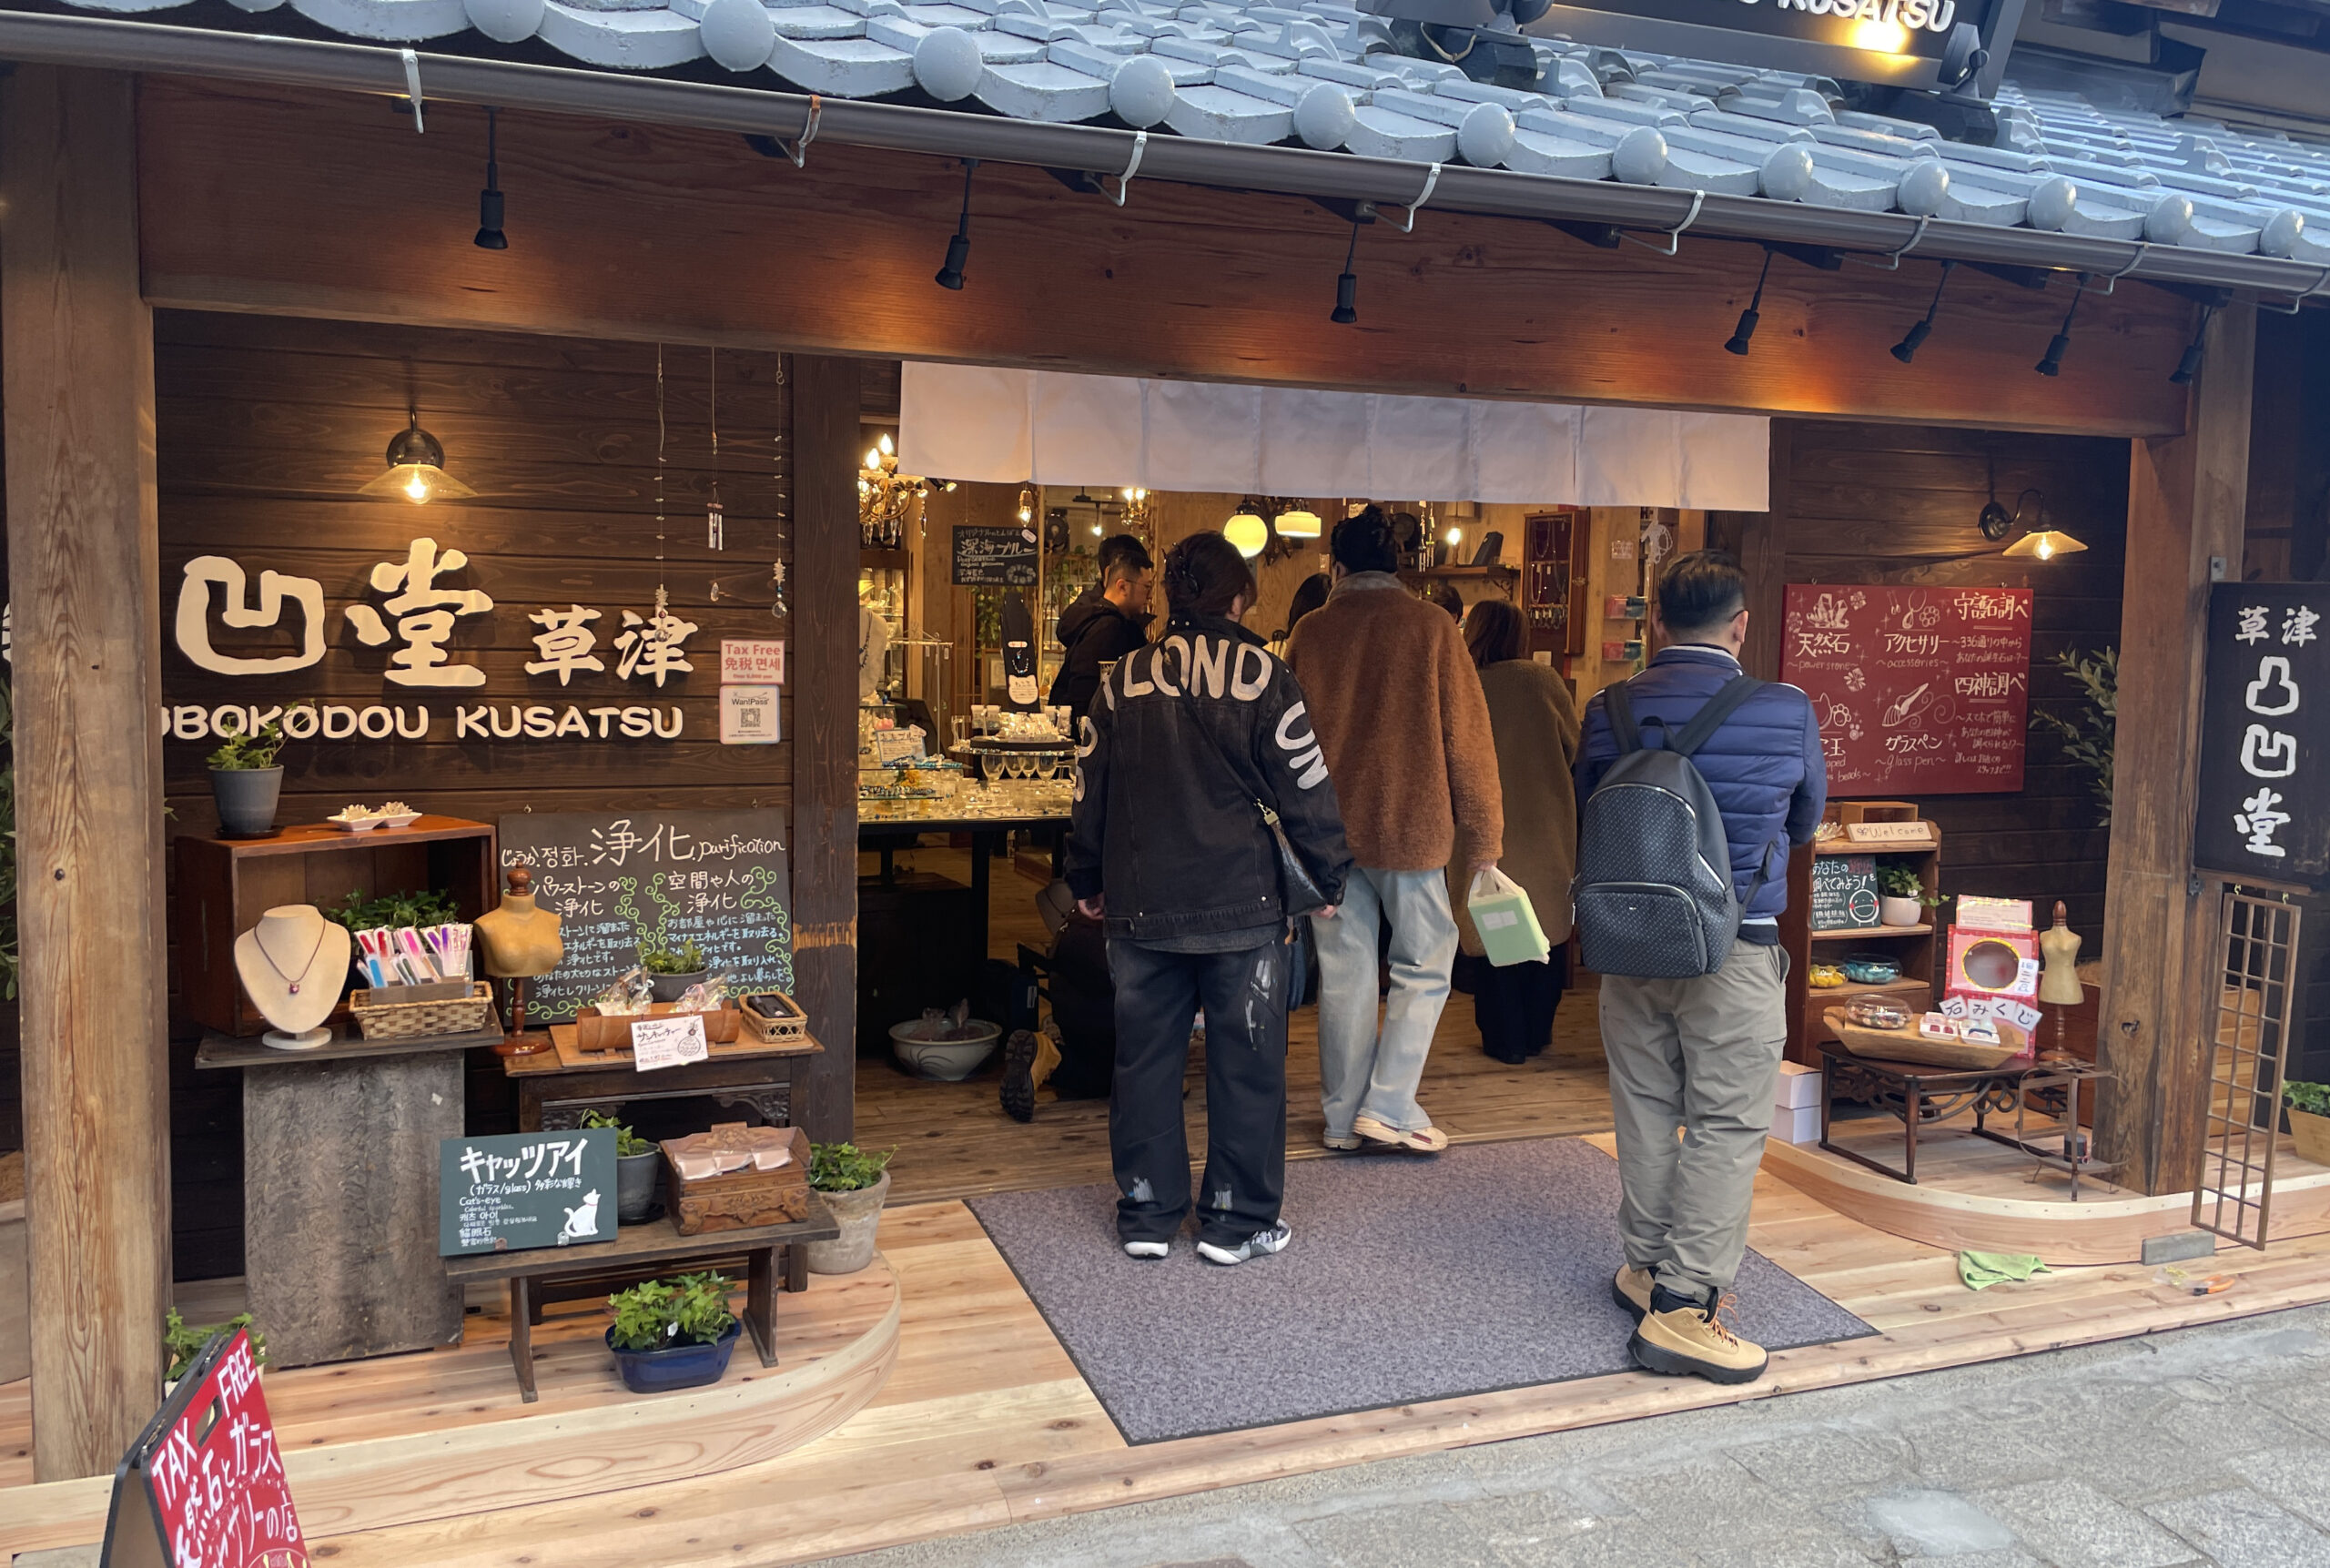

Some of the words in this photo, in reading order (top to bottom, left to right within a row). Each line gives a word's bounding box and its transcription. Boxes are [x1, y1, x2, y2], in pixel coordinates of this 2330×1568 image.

[176, 537, 493, 688] 凹堂
[524, 604, 698, 688] 草津
[2234, 604, 2321, 647] 草津
[725, 643, 749, 655] Tax
[753, 644, 781, 655] Free
[1795, 632, 1850, 658] 天然石
[1883, 633, 1950, 655] アクセサリー
[162, 704, 430, 740] BOKODOU
[456, 705, 683, 739] KUSATSU
[1885, 733, 1943, 754] ガラスペン
[2233, 655, 2300, 857] 凸凹堂
[697, 834, 785, 863] purification
[532, 875, 621, 896] パワーストーンの
[668, 868, 755, 891] 空間や人の
[554, 897, 604, 918] 浄化
[686, 892, 737, 914] 浄化
[460, 1138, 589, 1184] キャッツアイ
[151, 1417, 198, 1511] TAX
[217, 1338, 257, 1419] FREE
